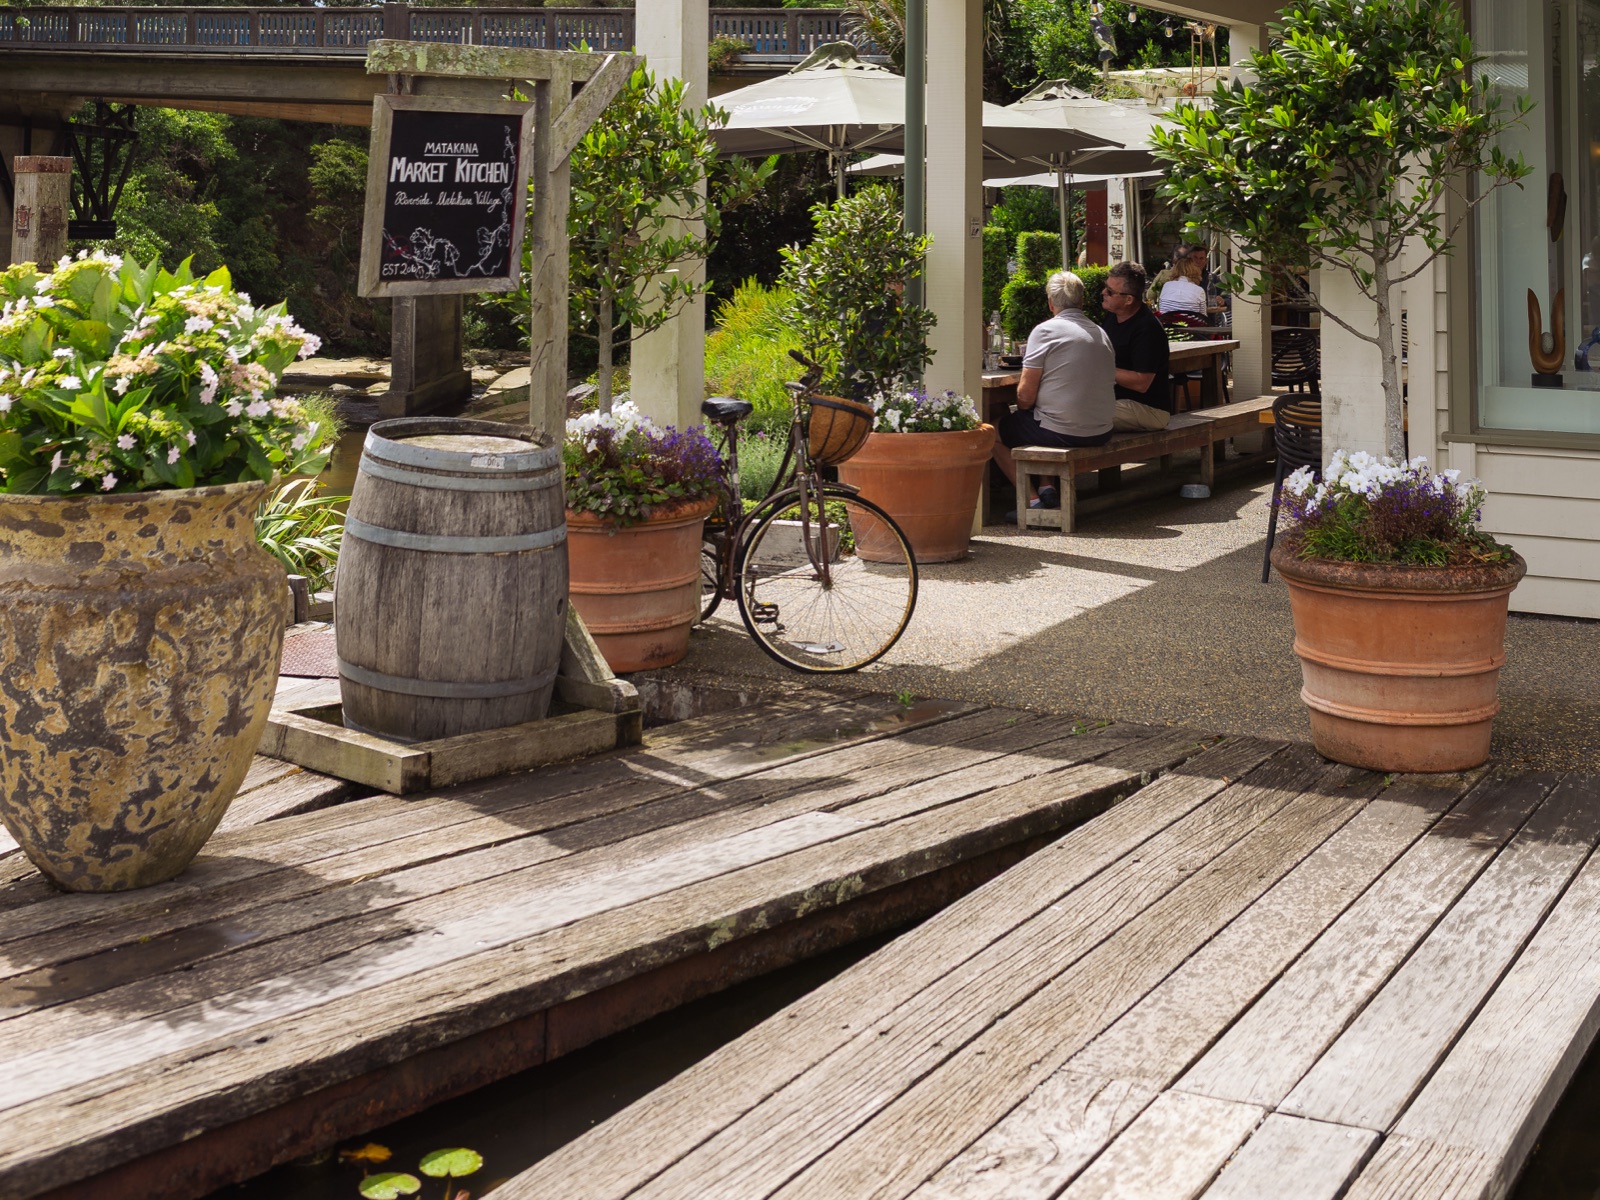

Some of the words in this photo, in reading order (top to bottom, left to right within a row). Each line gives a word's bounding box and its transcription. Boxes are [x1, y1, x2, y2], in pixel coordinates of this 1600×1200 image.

[424, 142, 479, 154] MATAKANA
[389, 157, 448, 183] MARKET
[454, 158, 509, 184] KITCHEN
